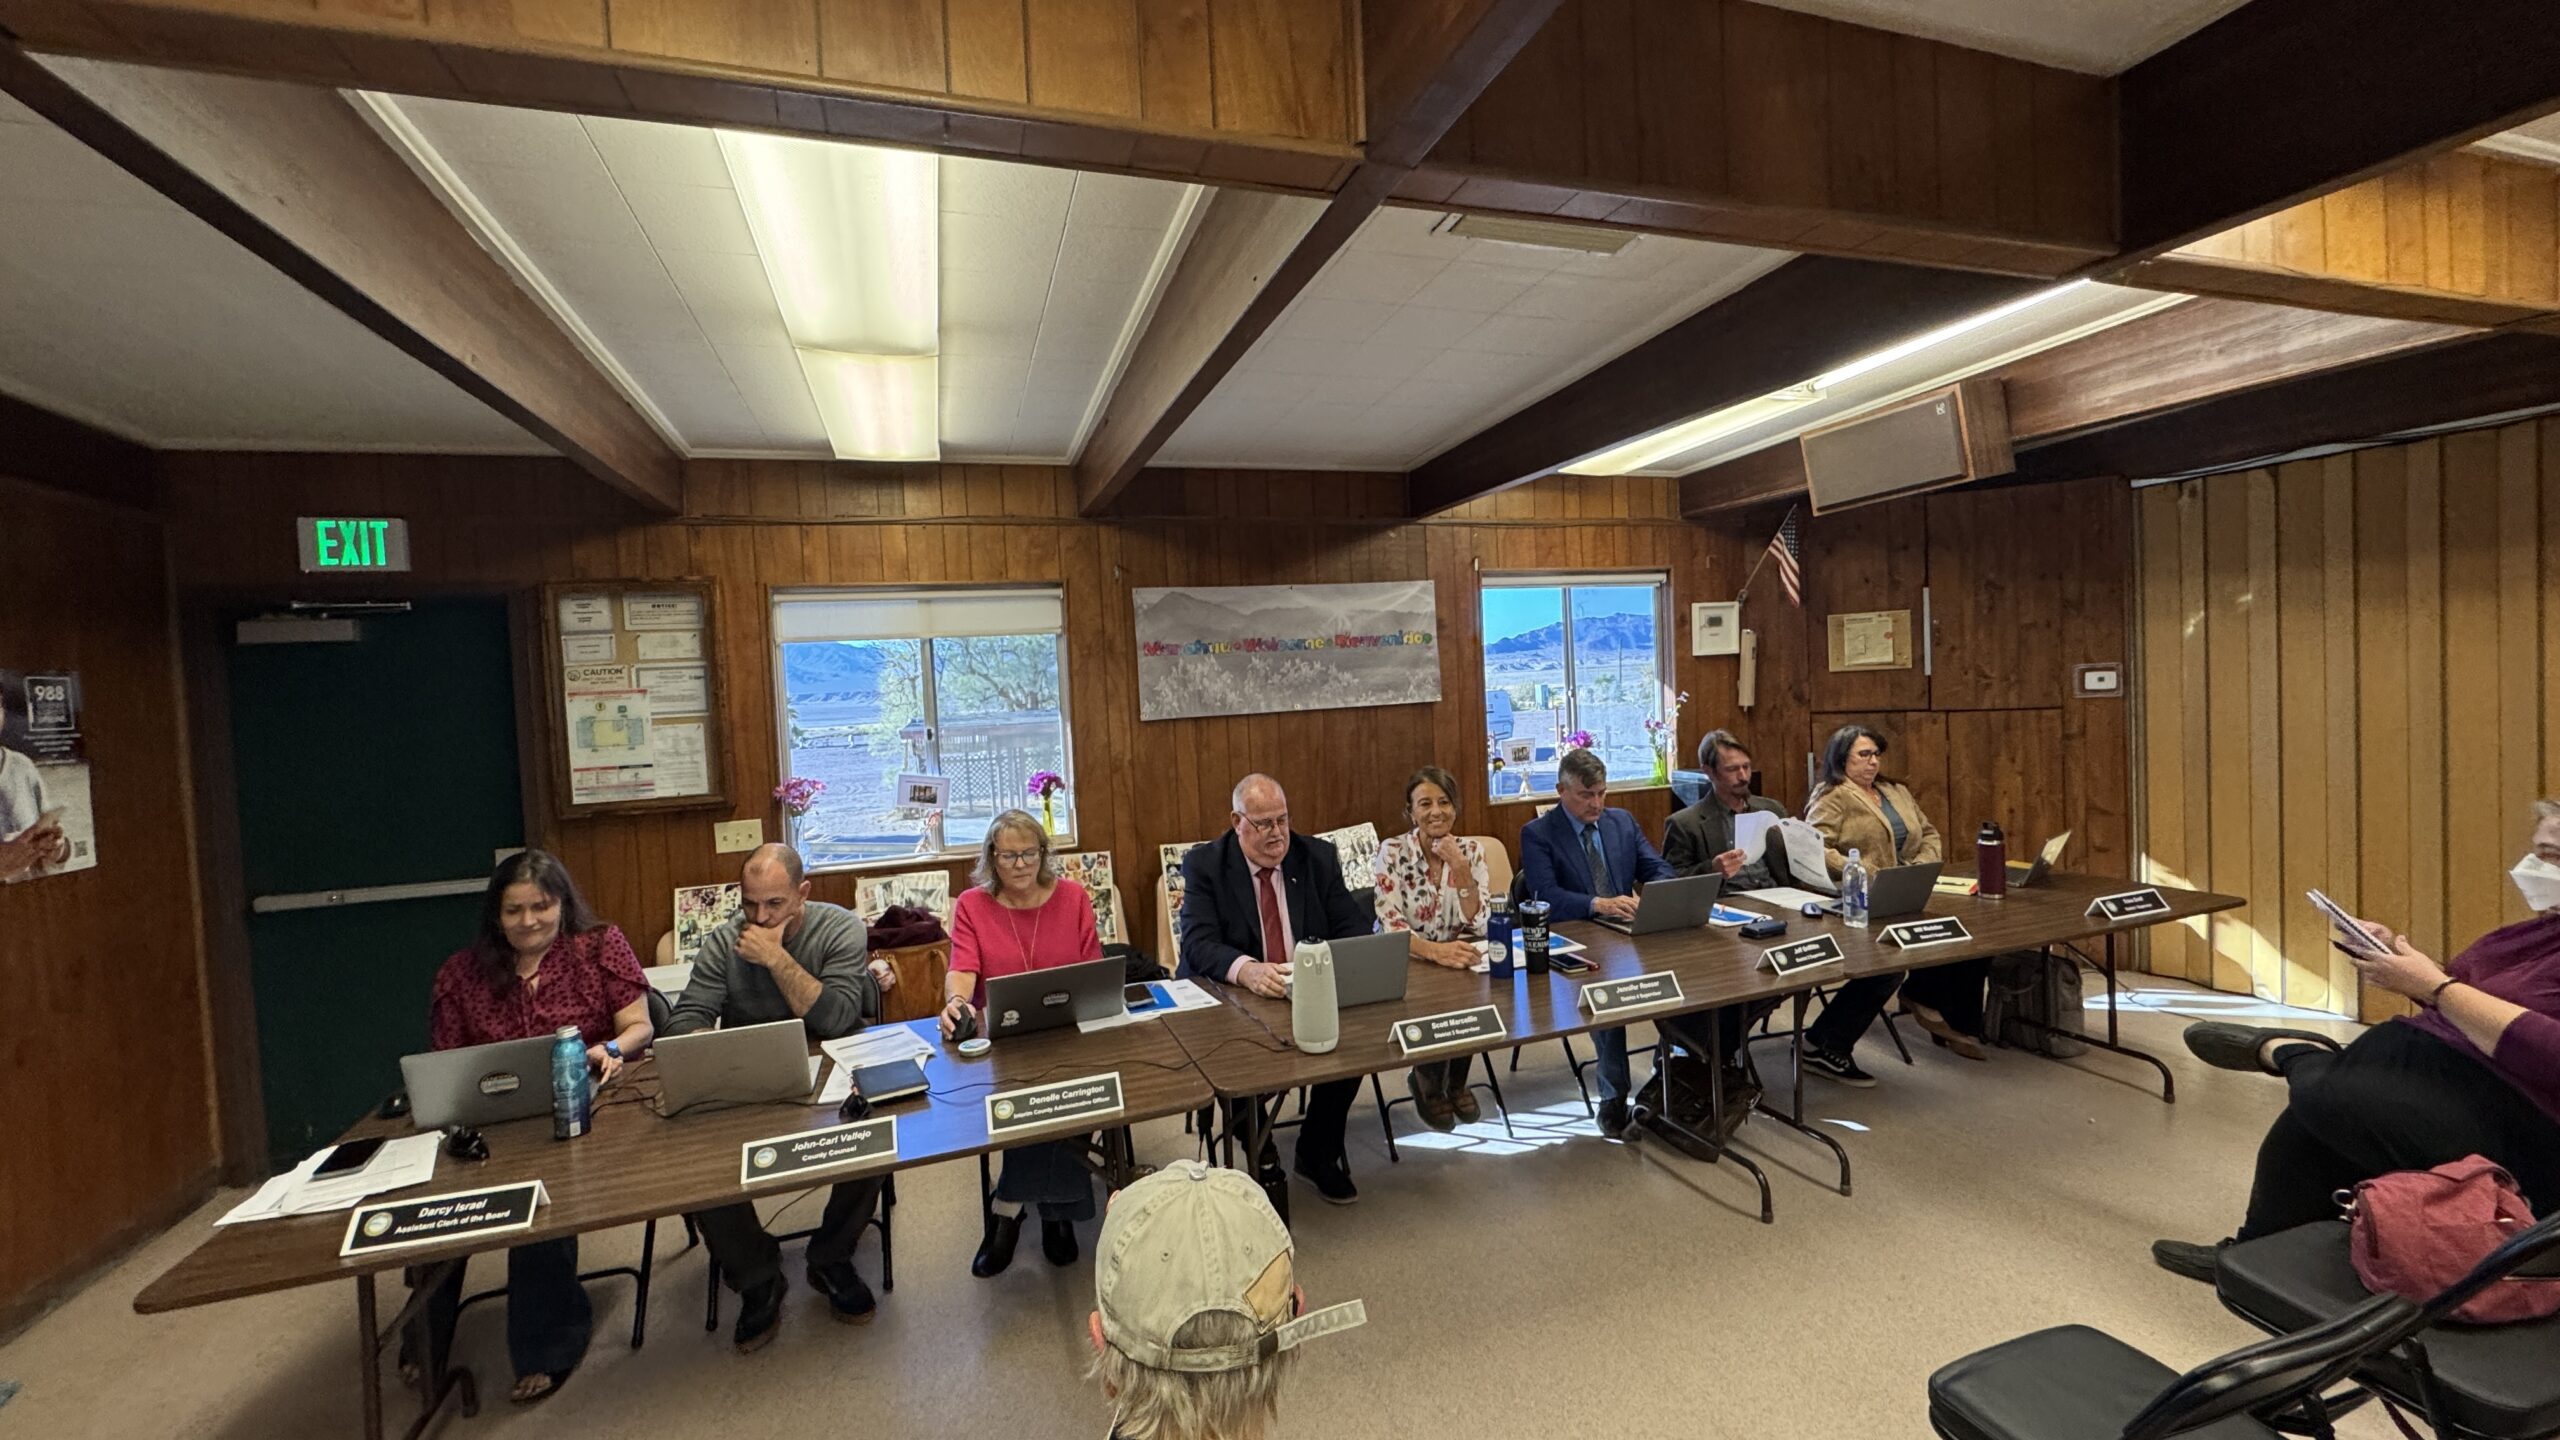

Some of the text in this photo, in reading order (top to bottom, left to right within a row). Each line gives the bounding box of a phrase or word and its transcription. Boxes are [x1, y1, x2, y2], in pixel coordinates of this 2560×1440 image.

[316, 520, 388, 566] EXIT
[583, 668, 623, 676] CAUTION
[34, 686, 65, 700] 988
[1431, 1020, 1448, 1030] Scott
[1029, 1085, 1104, 1106] Denelle Carrington
[1034, 1107, 1053, 1116] County
[792, 1130, 871, 1152] John-Carl Vallejo
[802, 1145, 857, 1162] County Counsel
[418, 1198, 488, 1218] Darcy Israel
[394, 1210, 511, 1235] Assistant Clerk of the Board
